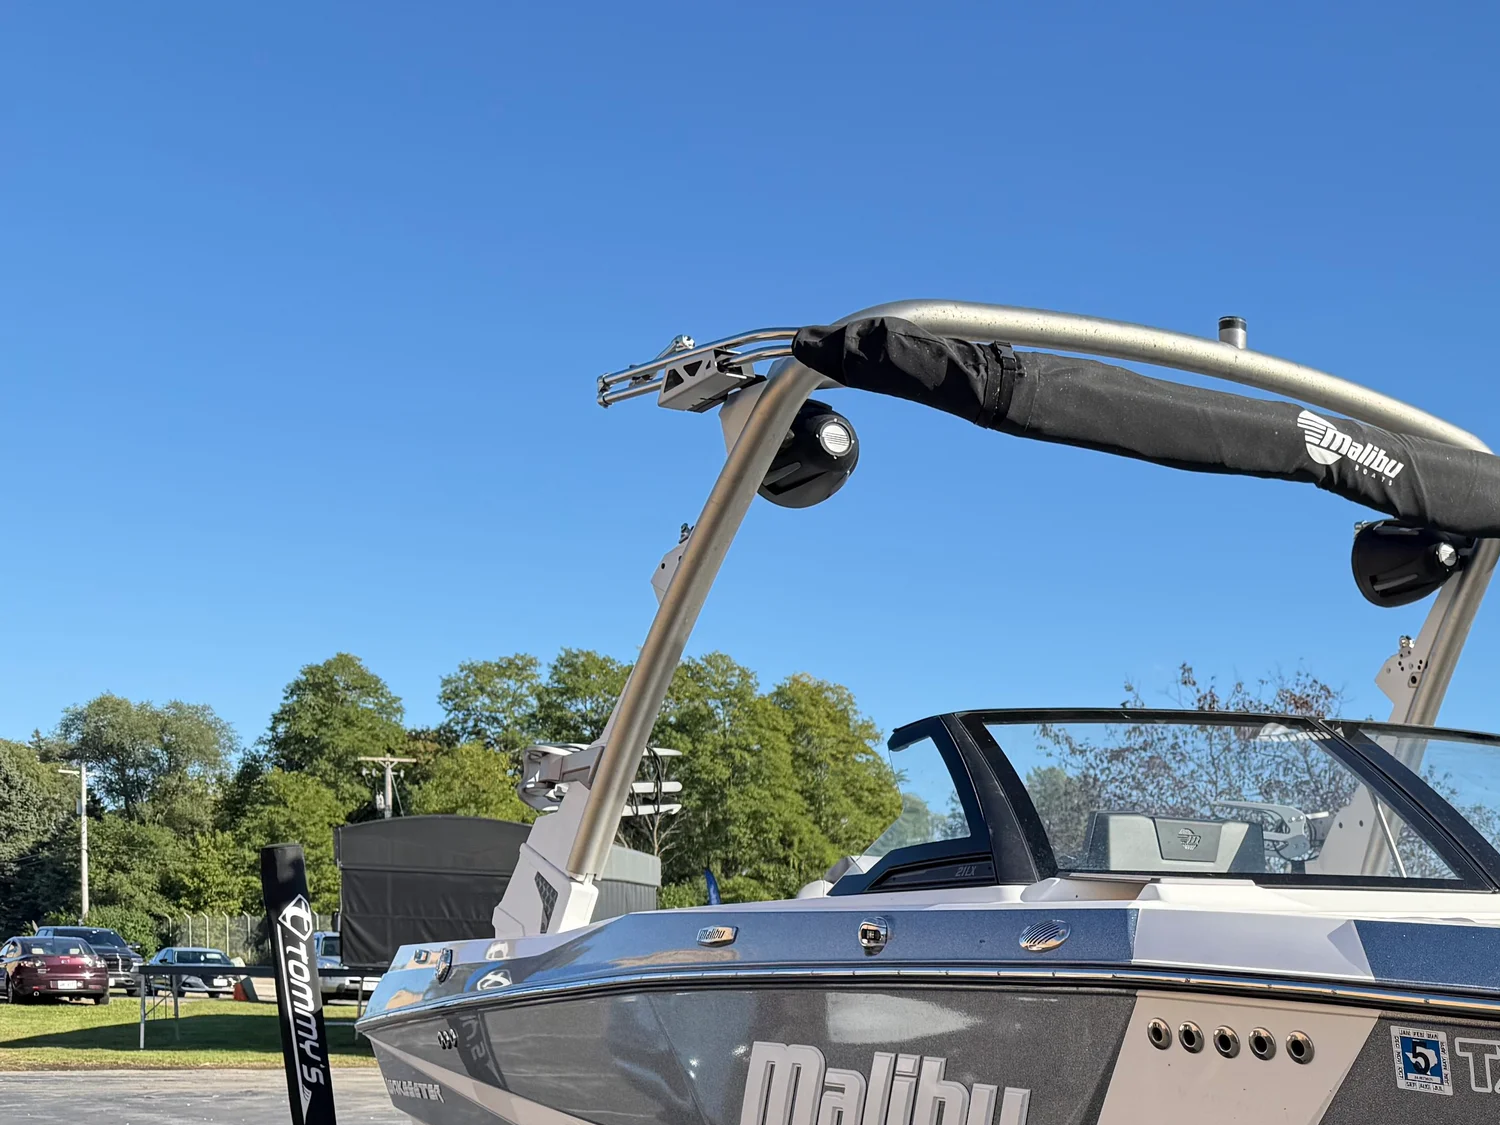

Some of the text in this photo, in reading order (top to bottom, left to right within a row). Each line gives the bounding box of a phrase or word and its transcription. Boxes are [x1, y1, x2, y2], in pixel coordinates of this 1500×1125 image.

[1319, 427, 1405, 479] Malibu
[1355, 464, 1393, 487] BOATS
[1412, 1040, 1430, 1075] 5
